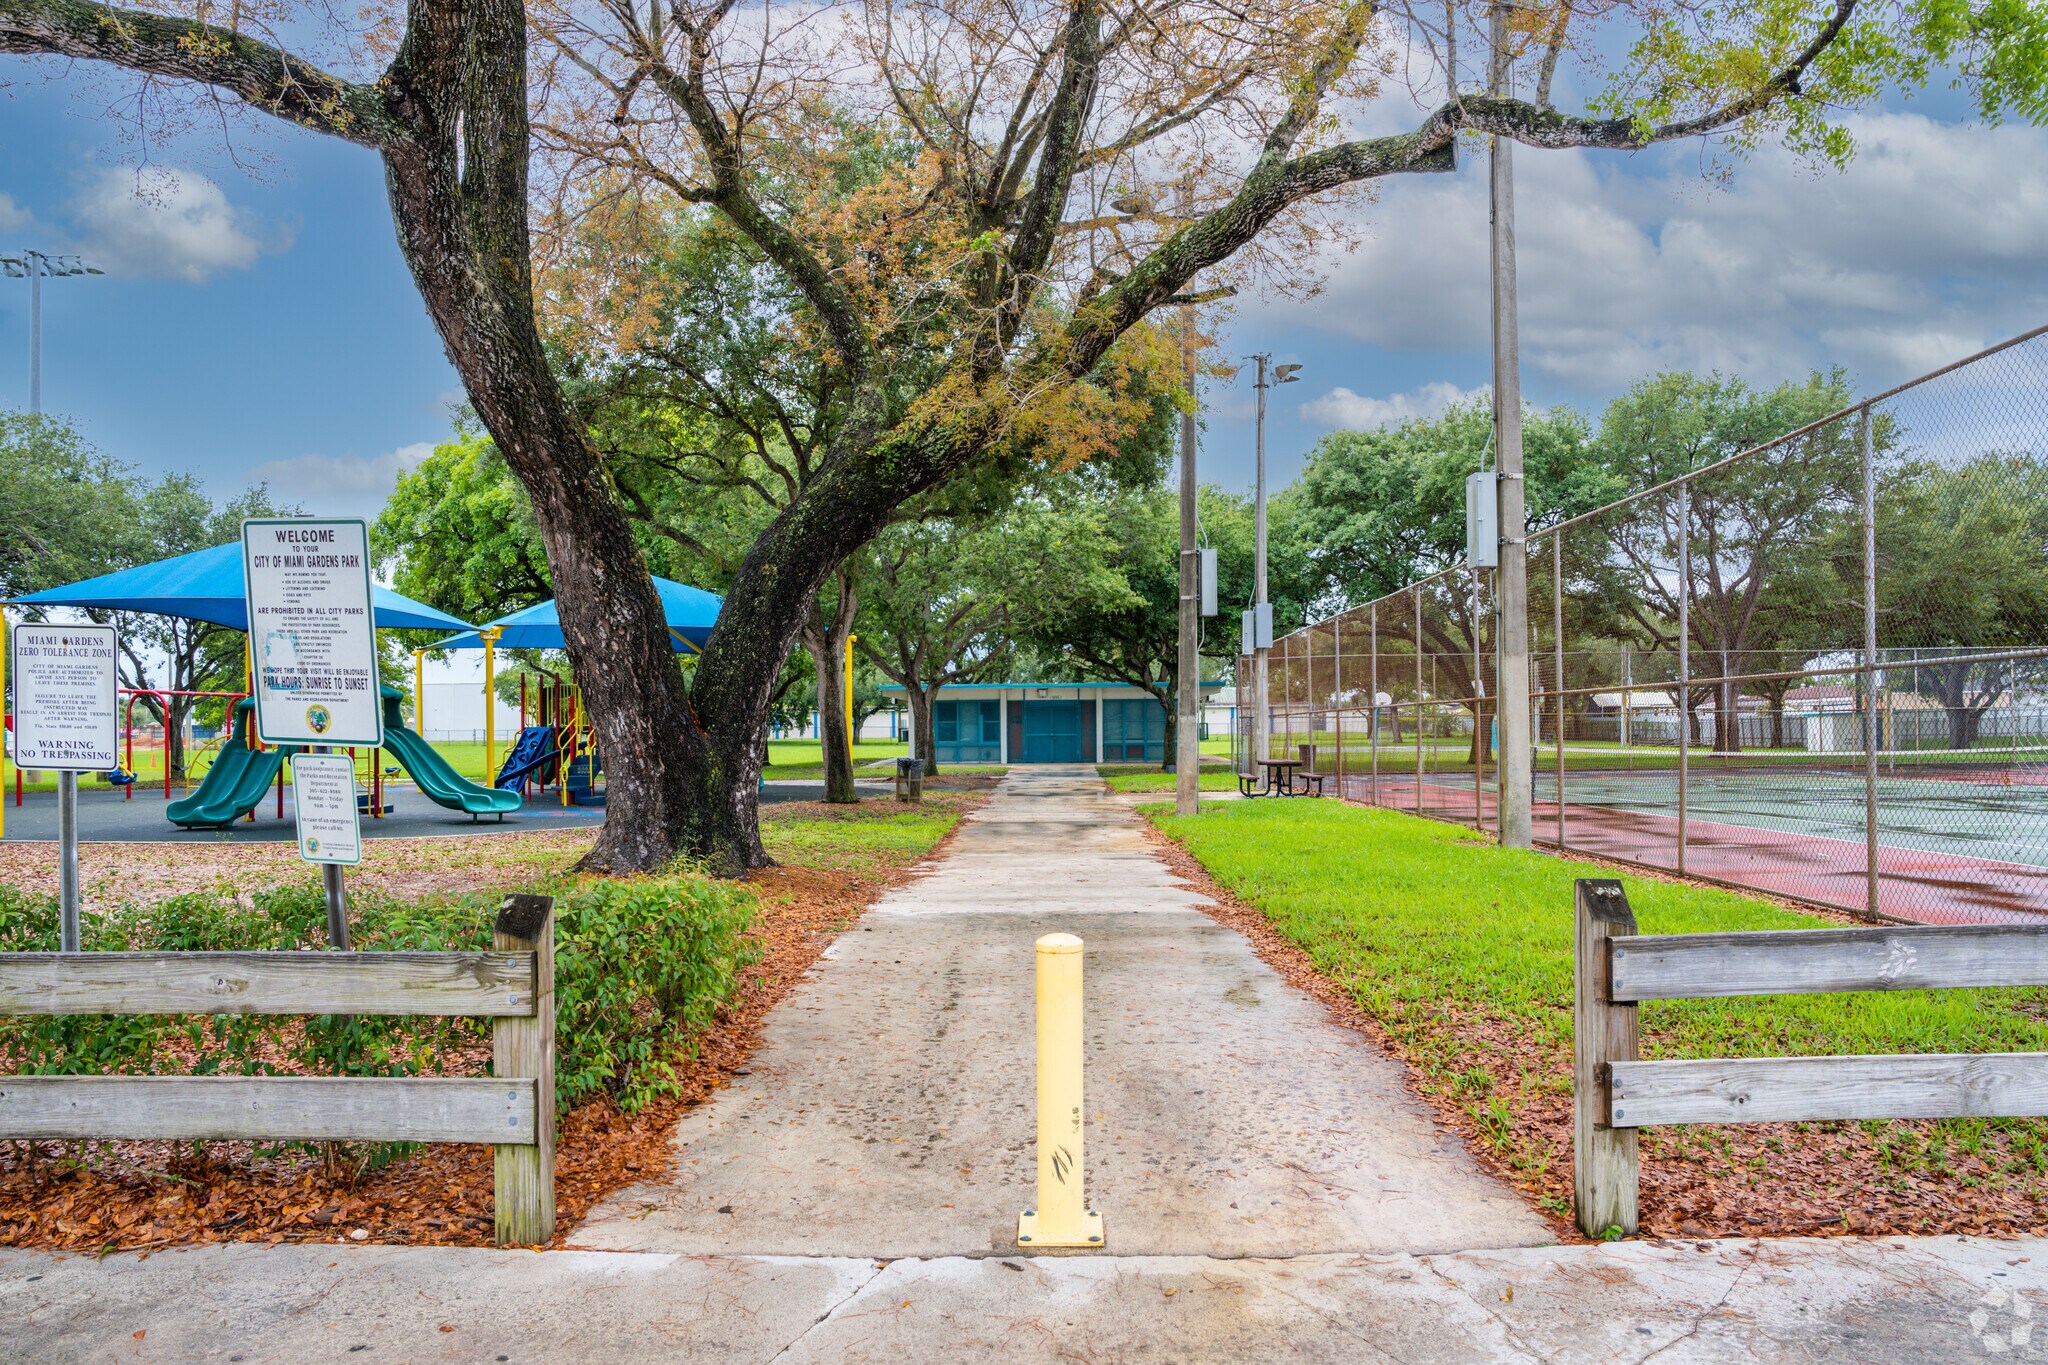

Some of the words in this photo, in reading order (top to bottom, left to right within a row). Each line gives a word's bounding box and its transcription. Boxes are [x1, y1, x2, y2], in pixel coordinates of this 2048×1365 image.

[275, 530, 335, 542] WELCOME
[254, 556, 270, 568] CITY
[273, 555, 281, 568] OF
[284, 555, 304, 568] MIAMI
[307, 555, 339, 568] GARDENS
[342, 555, 360, 568] PARK
[27, 636, 57, 645] MIAMI
[62, 636, 104, 646] GARDENS
[19, 647, 39, 656] ZERO
[42, 647, 88, 657] TOLERANCE
[92, 648, 112, 658] ZONE
[263, 676, 280, 688] PARK
[281, 676, 304, 688] HOURS:
[306, 677, 332, 689] SUNRISE
[334, 677, 342, 689] TO
[344, 678, 368, 690] SUNSET
[39, 740, 94, 749] WARNING
[20, 750, 36, 758] NO
[41, 750, 112, 760] TRESPASSING
